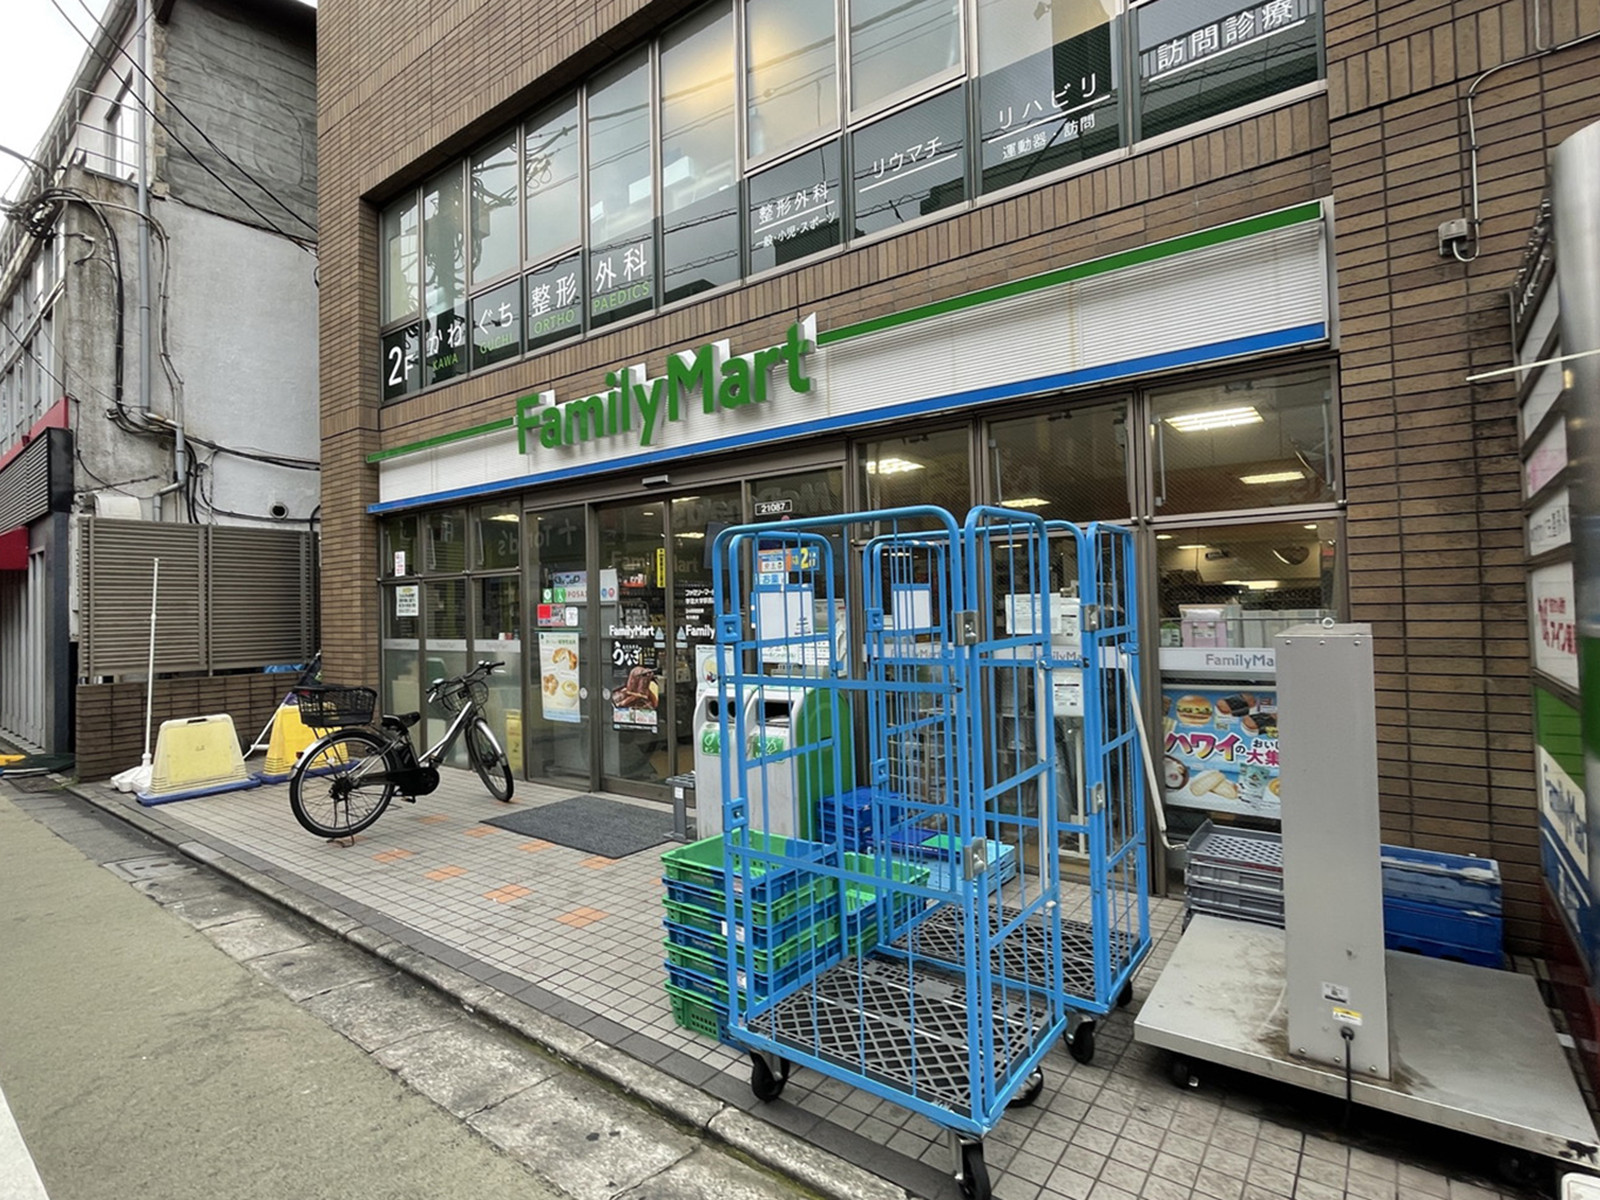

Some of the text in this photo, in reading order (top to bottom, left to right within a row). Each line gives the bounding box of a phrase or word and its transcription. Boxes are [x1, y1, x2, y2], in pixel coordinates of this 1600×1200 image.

[1157, 0, 1293, 71] 訪問診療
[999, 72, 1096, 130] リハビリ
[873, 136, 942, 179] リウマチ
[759, 180, 829, 226] 整形外科
[432, 281, 651, 372] KAWA GUCHI ORTHO PAEDICS
[388, 345, 413, 387] 2F
[515, 319, 814, 455] FamilyMart
[760, 501, 786, 514] 21087
[608, 624, 655, 639] FamilyMart
[1165, 732, 1246, 763] ハワイの
